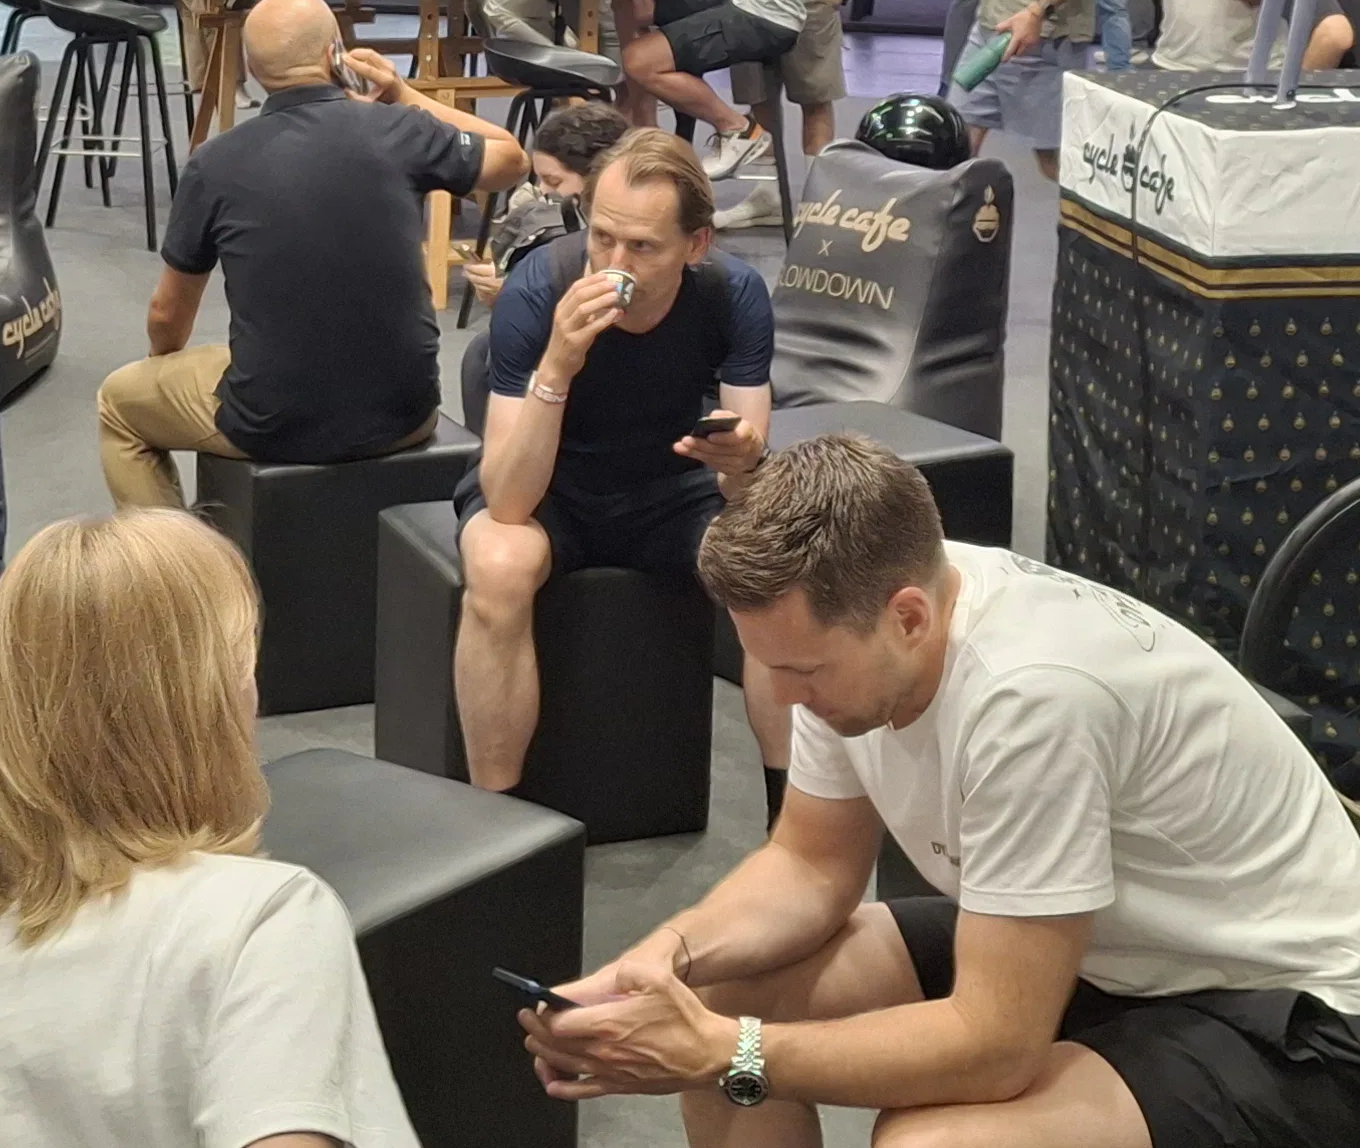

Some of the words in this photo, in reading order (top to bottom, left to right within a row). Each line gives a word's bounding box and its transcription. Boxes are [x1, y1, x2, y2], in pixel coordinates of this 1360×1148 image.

[1083, 133, 1118, 185] cycle
[1140, 154, 1176, 216] cafe
[839, 197, 911, 253] cafe
[3, 295, 44, 360] cycle
